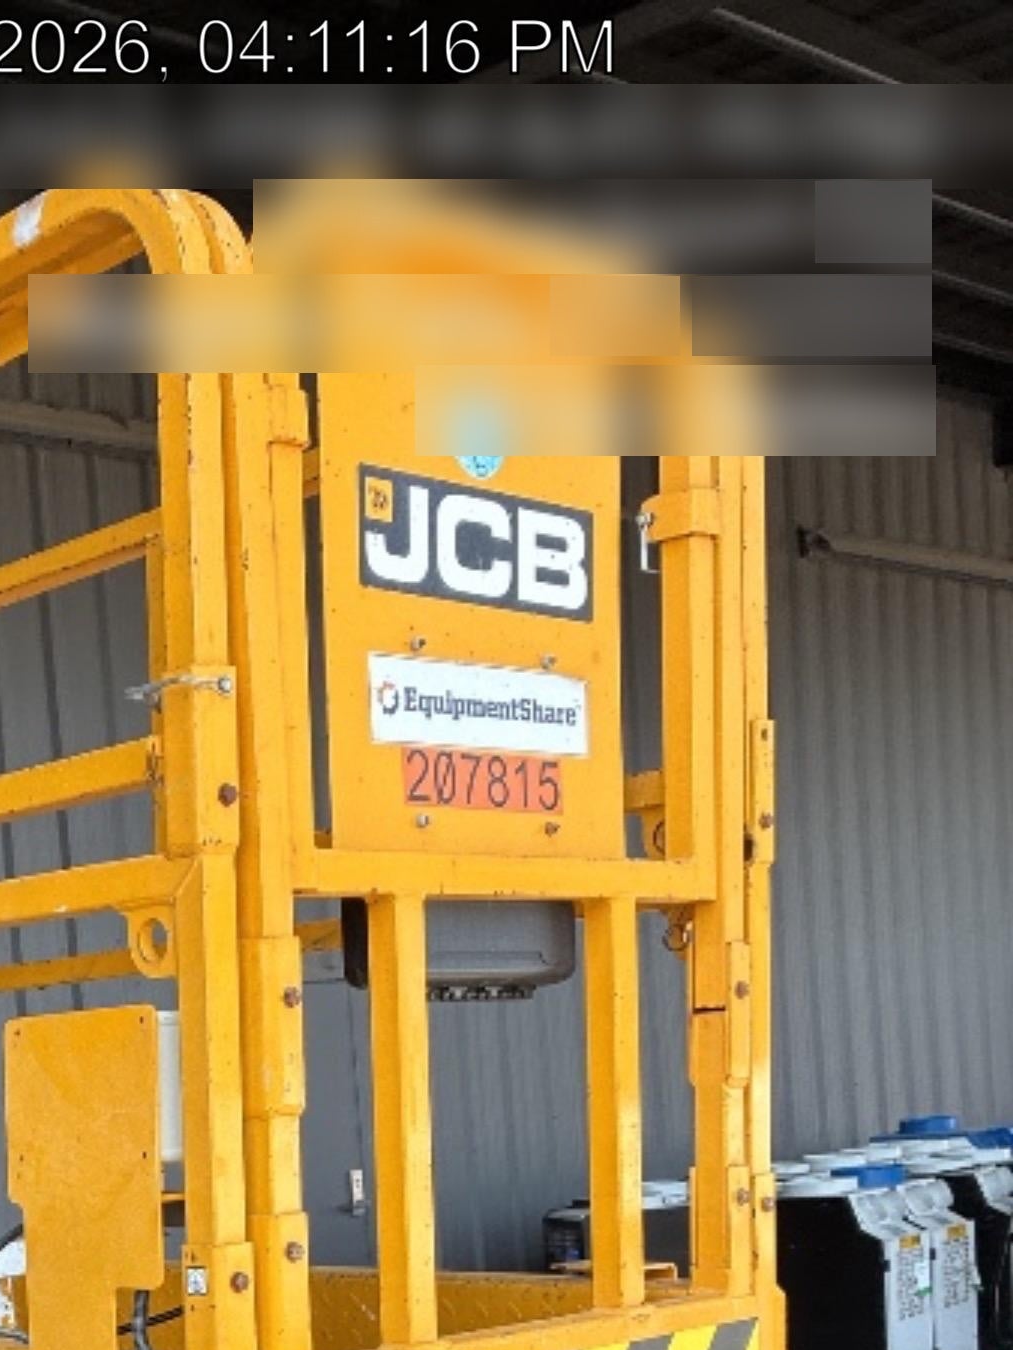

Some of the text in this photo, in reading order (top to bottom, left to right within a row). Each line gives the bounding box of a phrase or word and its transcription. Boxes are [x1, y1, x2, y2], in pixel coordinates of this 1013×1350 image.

[365, 485, 588, 610] JCB
[403, 685, 577, 726] EquipmentShare
[406, 749, 560, 811] 207815
